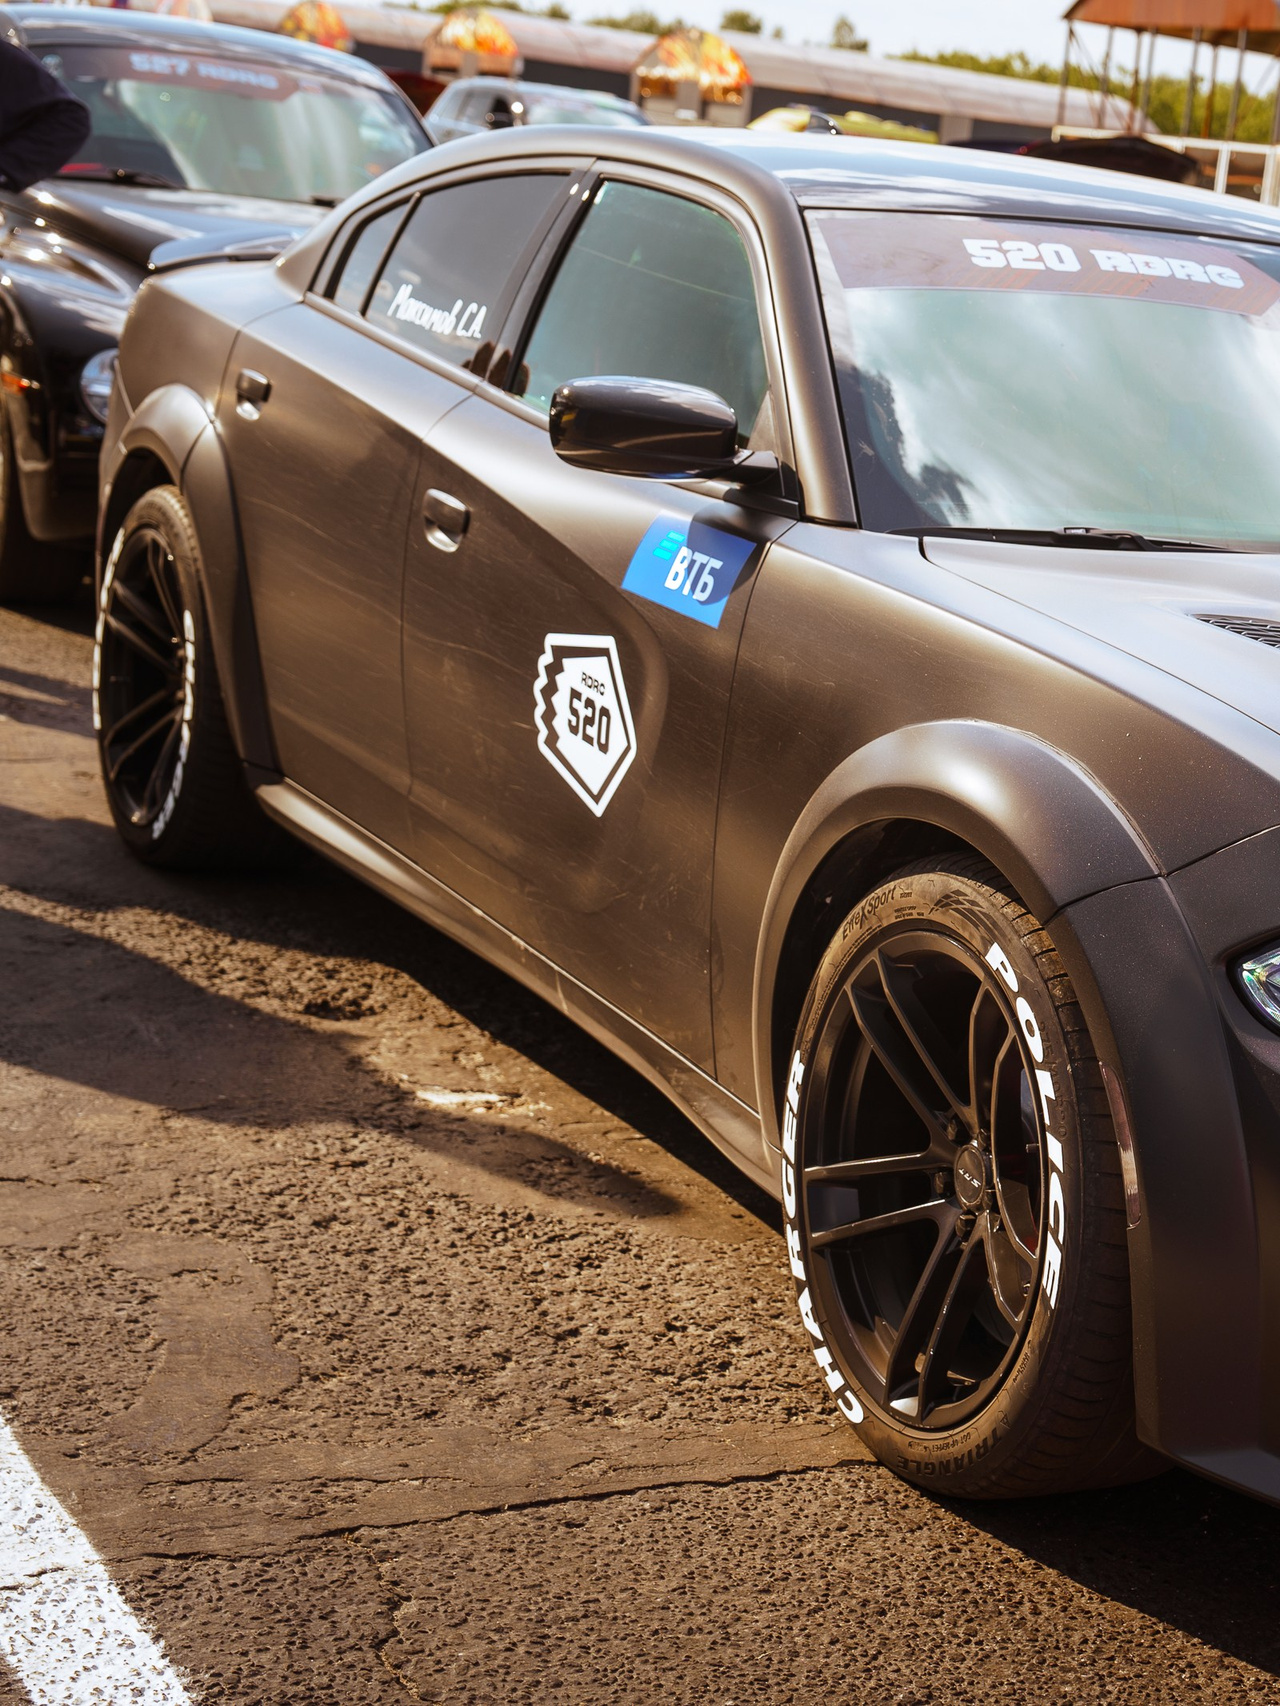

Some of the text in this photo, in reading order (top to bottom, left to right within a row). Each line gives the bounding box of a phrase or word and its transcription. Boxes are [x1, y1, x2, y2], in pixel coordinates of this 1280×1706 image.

[962, 238, 1082, 272] 520
[664, 545, 724, 602] ВТБ
[581, 671, 606, 696] RDRC
[568, 687, 611, 755] 520
[985, 941, 1066, 1310] POLICE
[959, 1168, 982, 1188] SRT
[781, 1050, 865, 1424] CHARGER
[896, 1427, 1002, 1476] TRIANGLE
